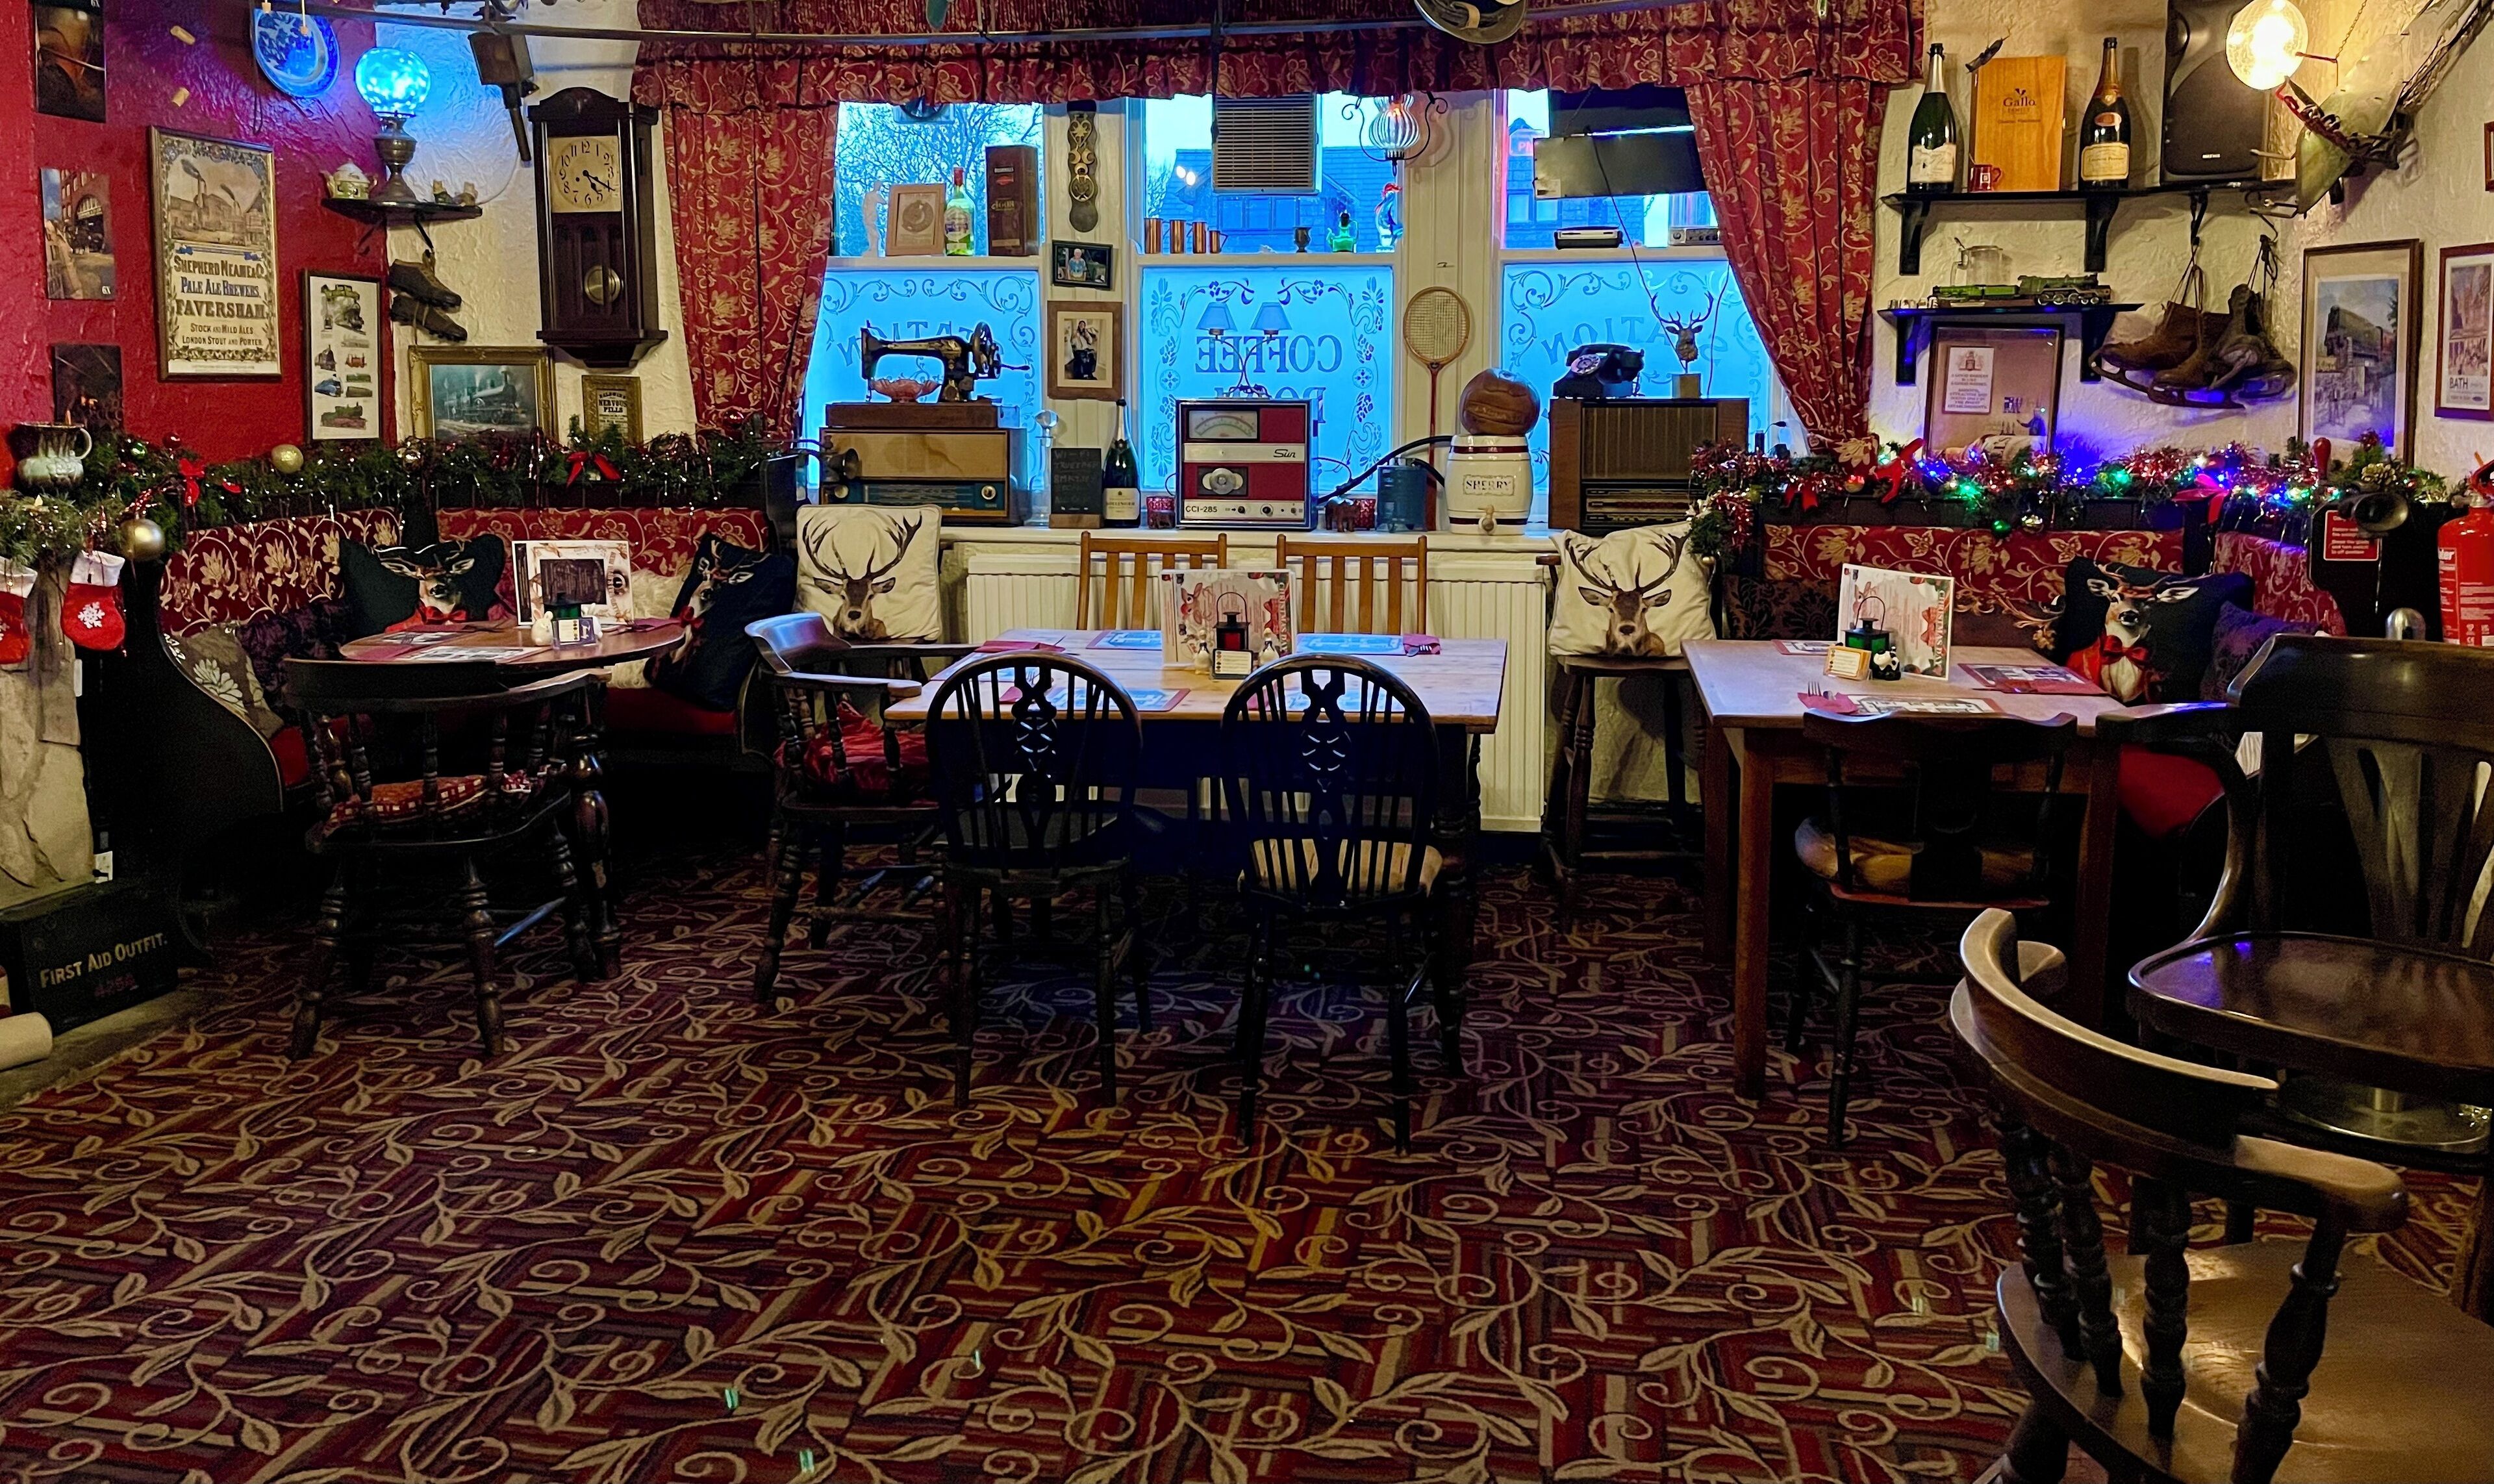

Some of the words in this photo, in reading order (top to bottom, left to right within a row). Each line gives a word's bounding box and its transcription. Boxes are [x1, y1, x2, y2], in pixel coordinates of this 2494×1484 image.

[2003, 97, 2036, 107] Gallo
[571, 145, 577, 157] 11
[582, 141, 590, 153] 12
[561, 155, 570, 167] 10
[603, 153, 609, 166] 2
[559, 168, 566, 180] 9
[608, 166, 614, 179] 3
[564, 181, 570, 194] 8
[572, 190, 579, 203] 7
[585, 193, 592, 208] 6
[597, 189, 603, 202] 5
[174, 255, 220, 275] SHEPHERD
[181, 277, 203, 294] PALE
[205, 279, 221, 295] ALE
[175, 299, 267, 319] FAVERSHAM
[190, 323, 212, 333] STOCK
[221, 325, 238, 334] MILD
[239, 325, 254, 334] ALES
[182, 335, 207, 345] LONDON
[207, 336, 227, 346] STOUT
[2449, 377, 2469, 390] BATH
[599, 399, 628, 407] NERVOUS
[1273, 449, 1296, 459] Sun
[1466, 479, 1512, 491] SHERRY
[1278, 582, 1287, 633] CHRISTMAS
[1935, 590, 1945, 646] CHRISTMAS
[1934, 647, 1943, 666] DAY
[40, 961, 82, 988] FIRST
[88, 951, 112, 972] AID
[115, 933, 168, 961] OUTFIT.
